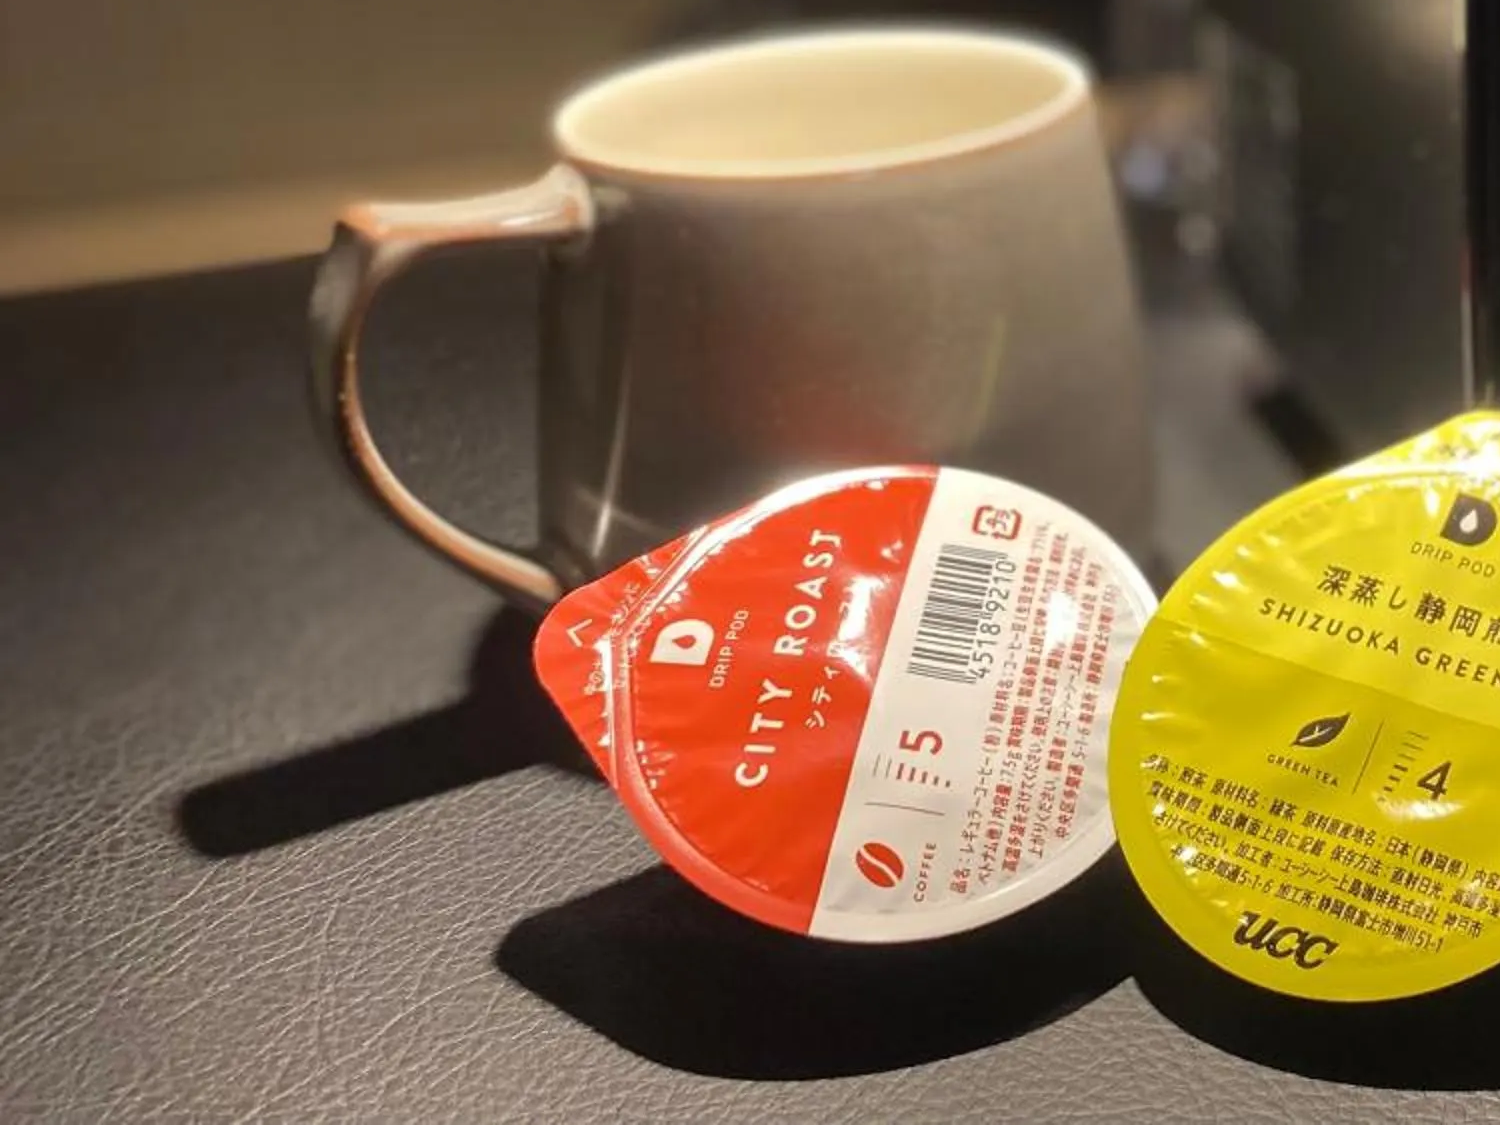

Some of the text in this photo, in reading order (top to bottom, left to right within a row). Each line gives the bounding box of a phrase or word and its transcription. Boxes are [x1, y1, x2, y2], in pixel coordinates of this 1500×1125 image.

[1409, 541, 1497, 579] DRIP POD
[708, 606, 750, 689] DRIP POD
[966, 557, 1017, 680] 4518 9210
[1259, 597, 1401, 657] SHIZUOKA
[733, 526, 842, 791] CITY ROAST
[899, 729, 943, 756] 5
[1265, 753, 1340, 788] GREEN TEA
[1416, 761, 1454, 801] 4
[911, 841, 938, 903] COFFEE
